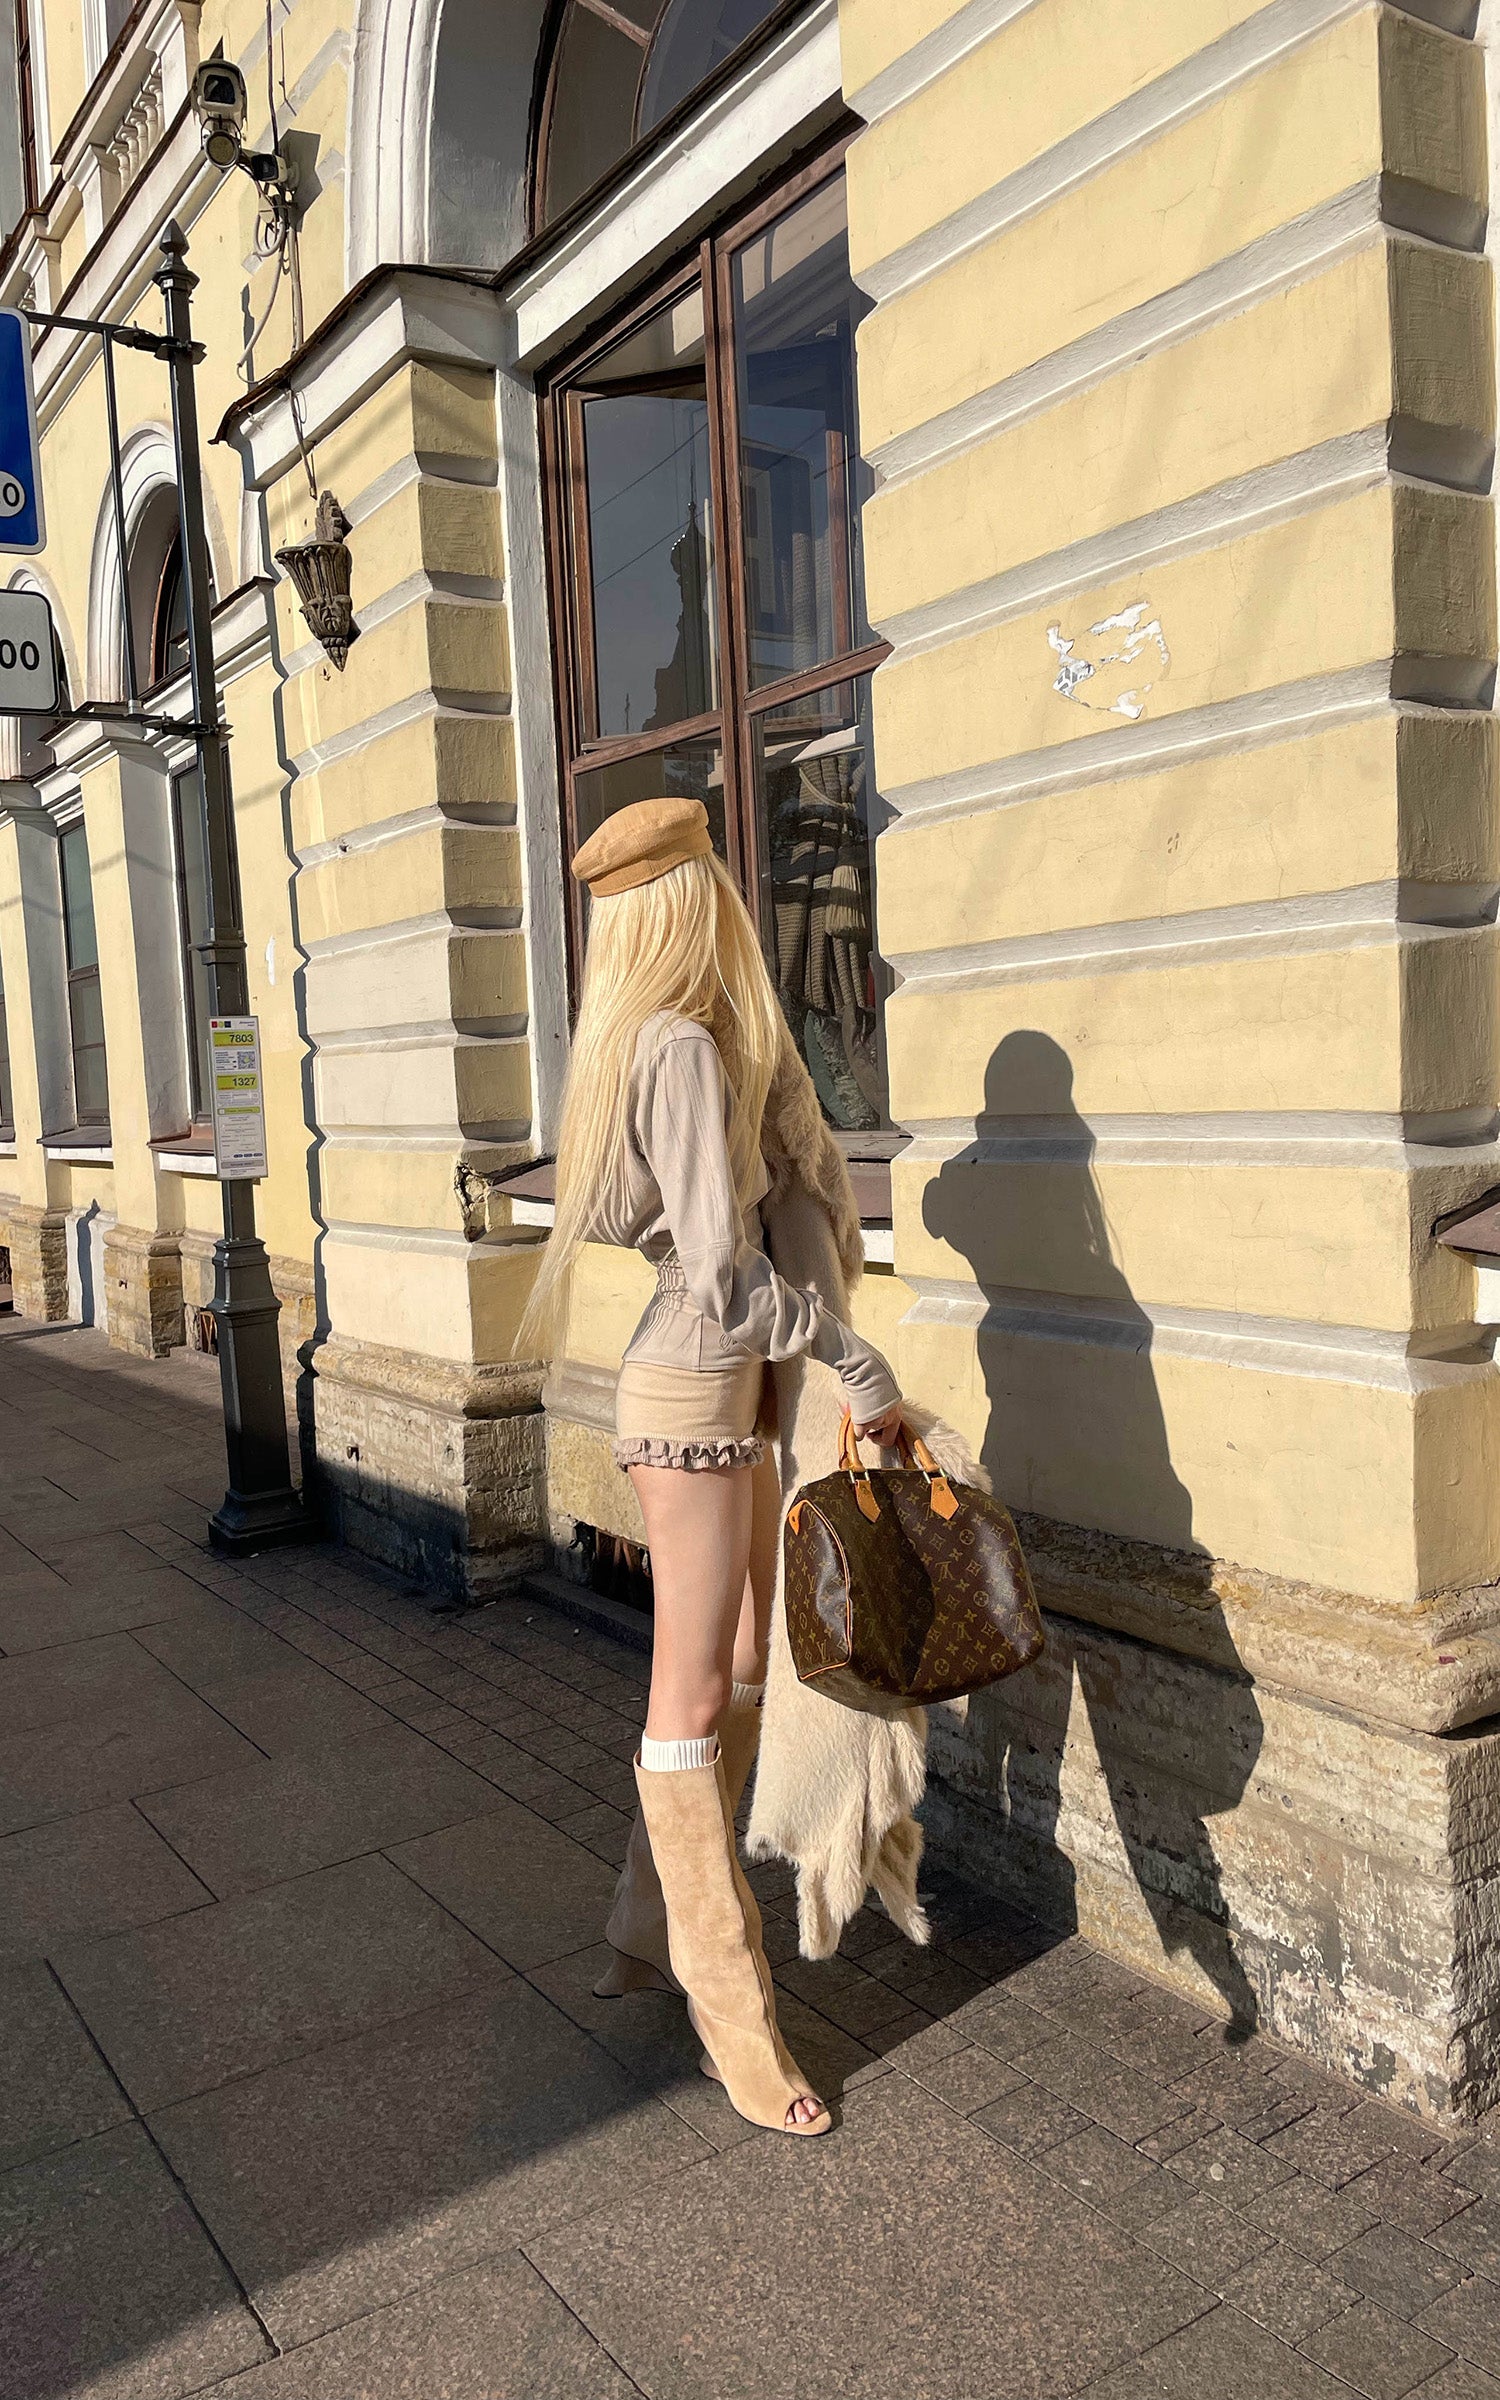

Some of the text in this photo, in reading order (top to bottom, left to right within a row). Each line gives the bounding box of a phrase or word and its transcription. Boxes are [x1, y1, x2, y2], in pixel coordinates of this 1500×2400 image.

[0, 638, 40, 671] 00
[229, 1033, 254, 1043] 7803
[232, 1077, 256, 1086] 1327
